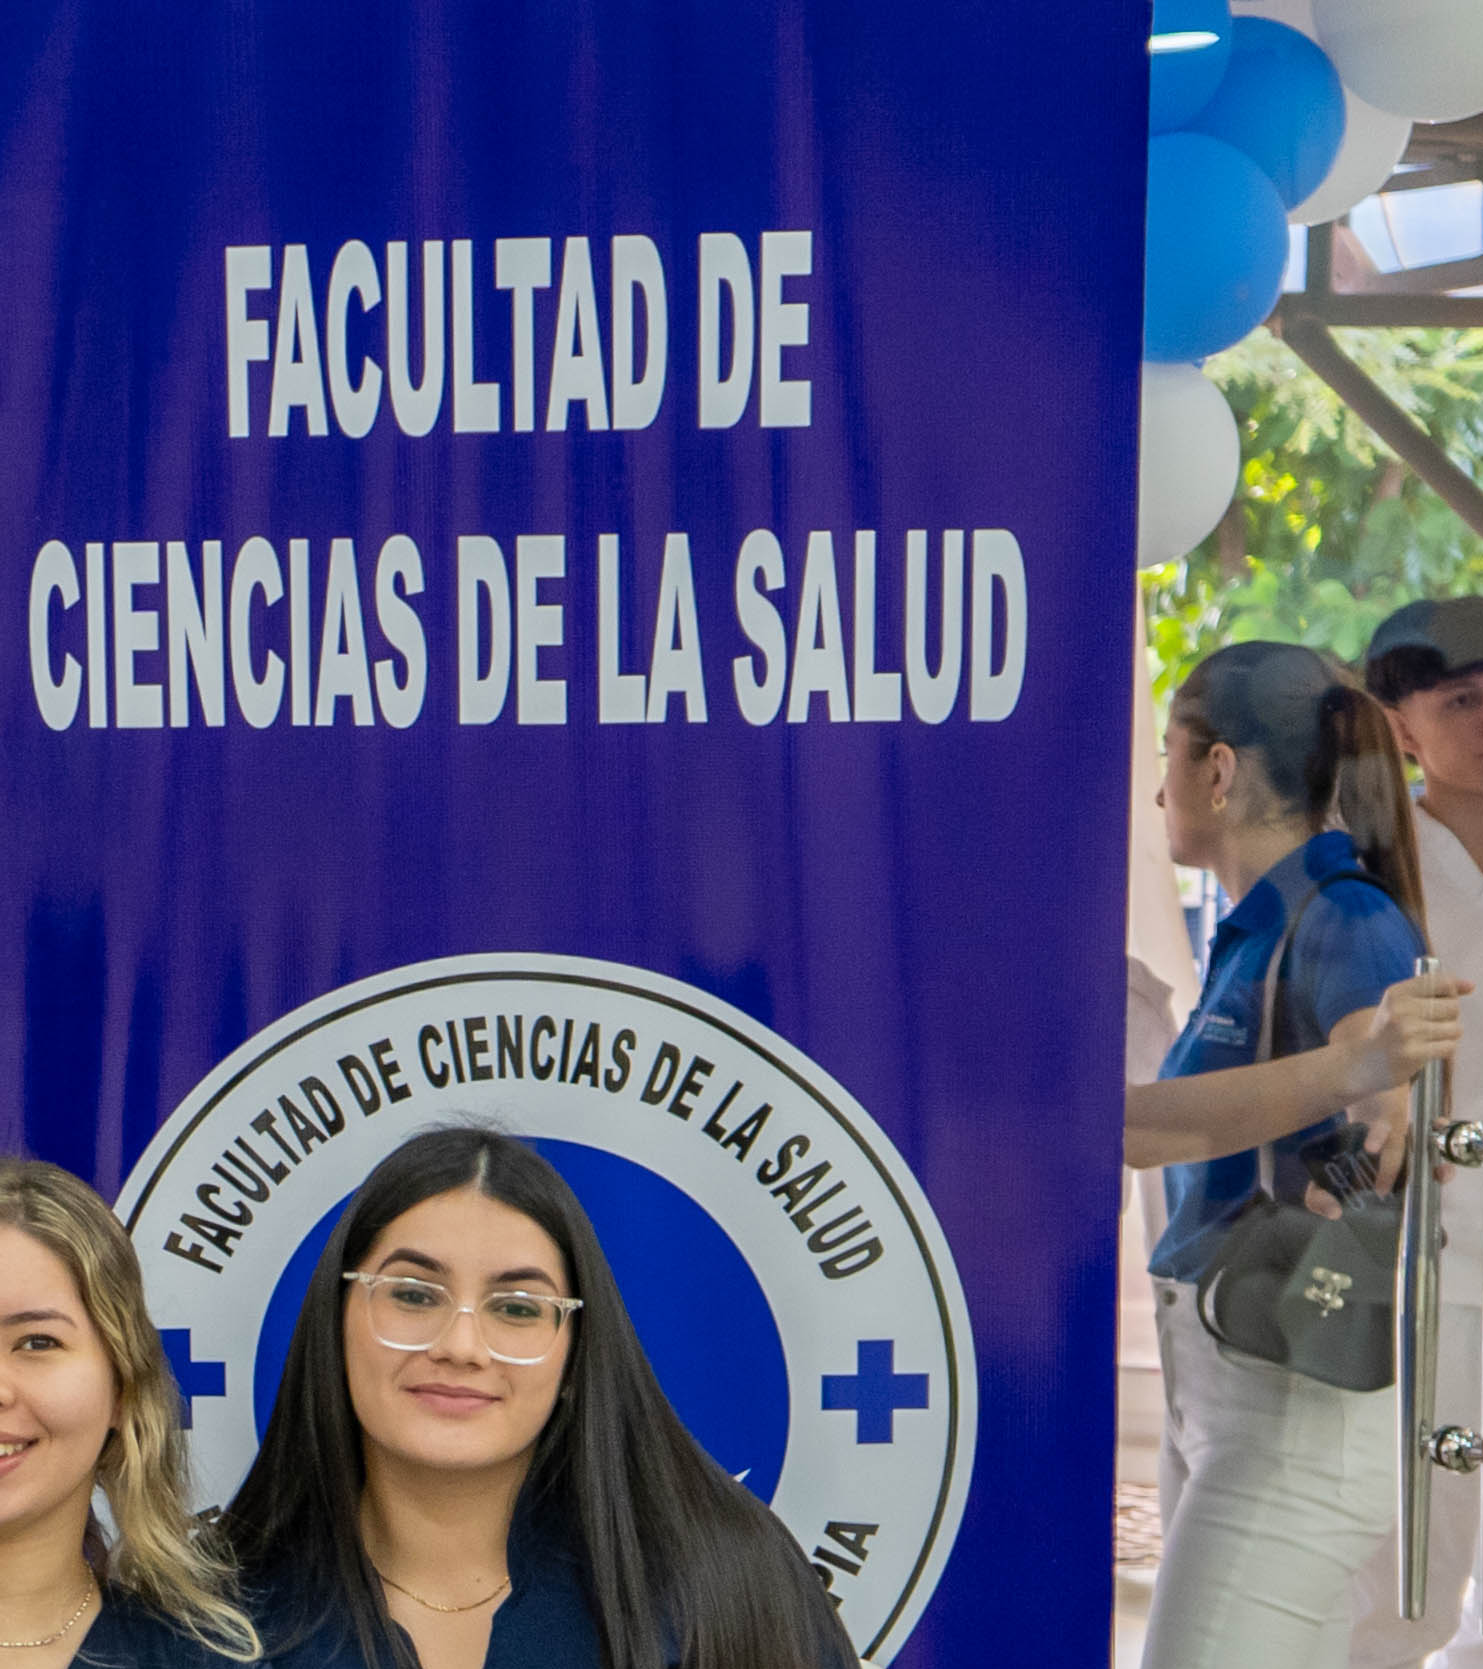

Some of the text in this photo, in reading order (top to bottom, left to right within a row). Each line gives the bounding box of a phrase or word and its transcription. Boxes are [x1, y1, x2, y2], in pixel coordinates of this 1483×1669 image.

[225, 230, 812, 438] FACULTAD DE
[29, 528, 1029, 731] CIENCIAS DE LA SALUD
[163, 1014, 884, 1280] FACULTAD DE CIENCIAS DE LA SALUD
